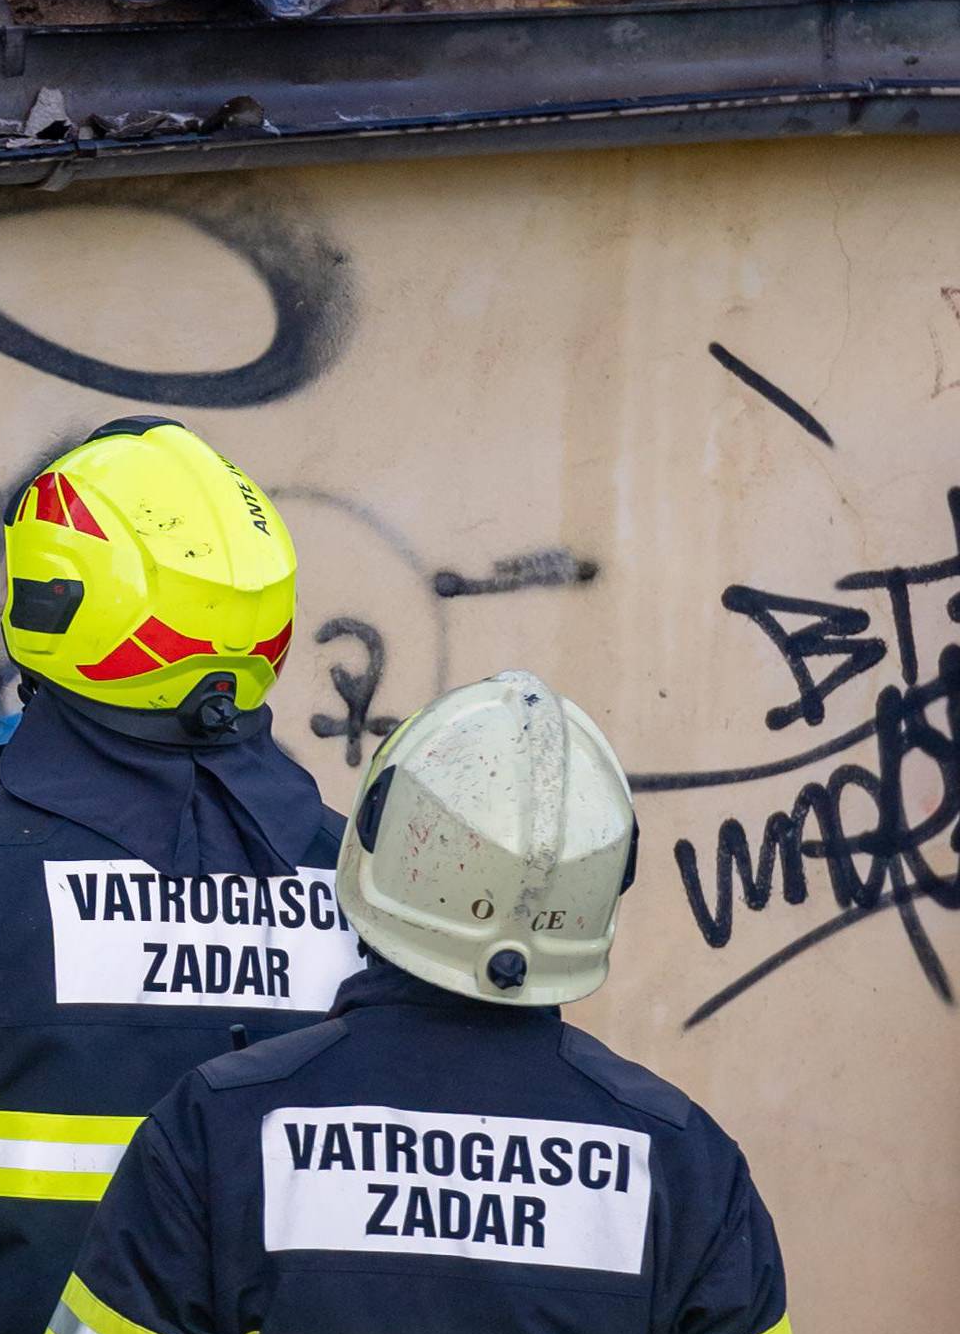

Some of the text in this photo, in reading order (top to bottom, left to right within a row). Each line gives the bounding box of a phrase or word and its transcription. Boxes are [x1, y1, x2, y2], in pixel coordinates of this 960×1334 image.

[236, 480, 271, 537] ANTE
[142, 943, 291, 998] ZADAR
[284, 1122, 630, 1193] VATROGASCI
[365, 1183, 546, 1249] ZADAR
